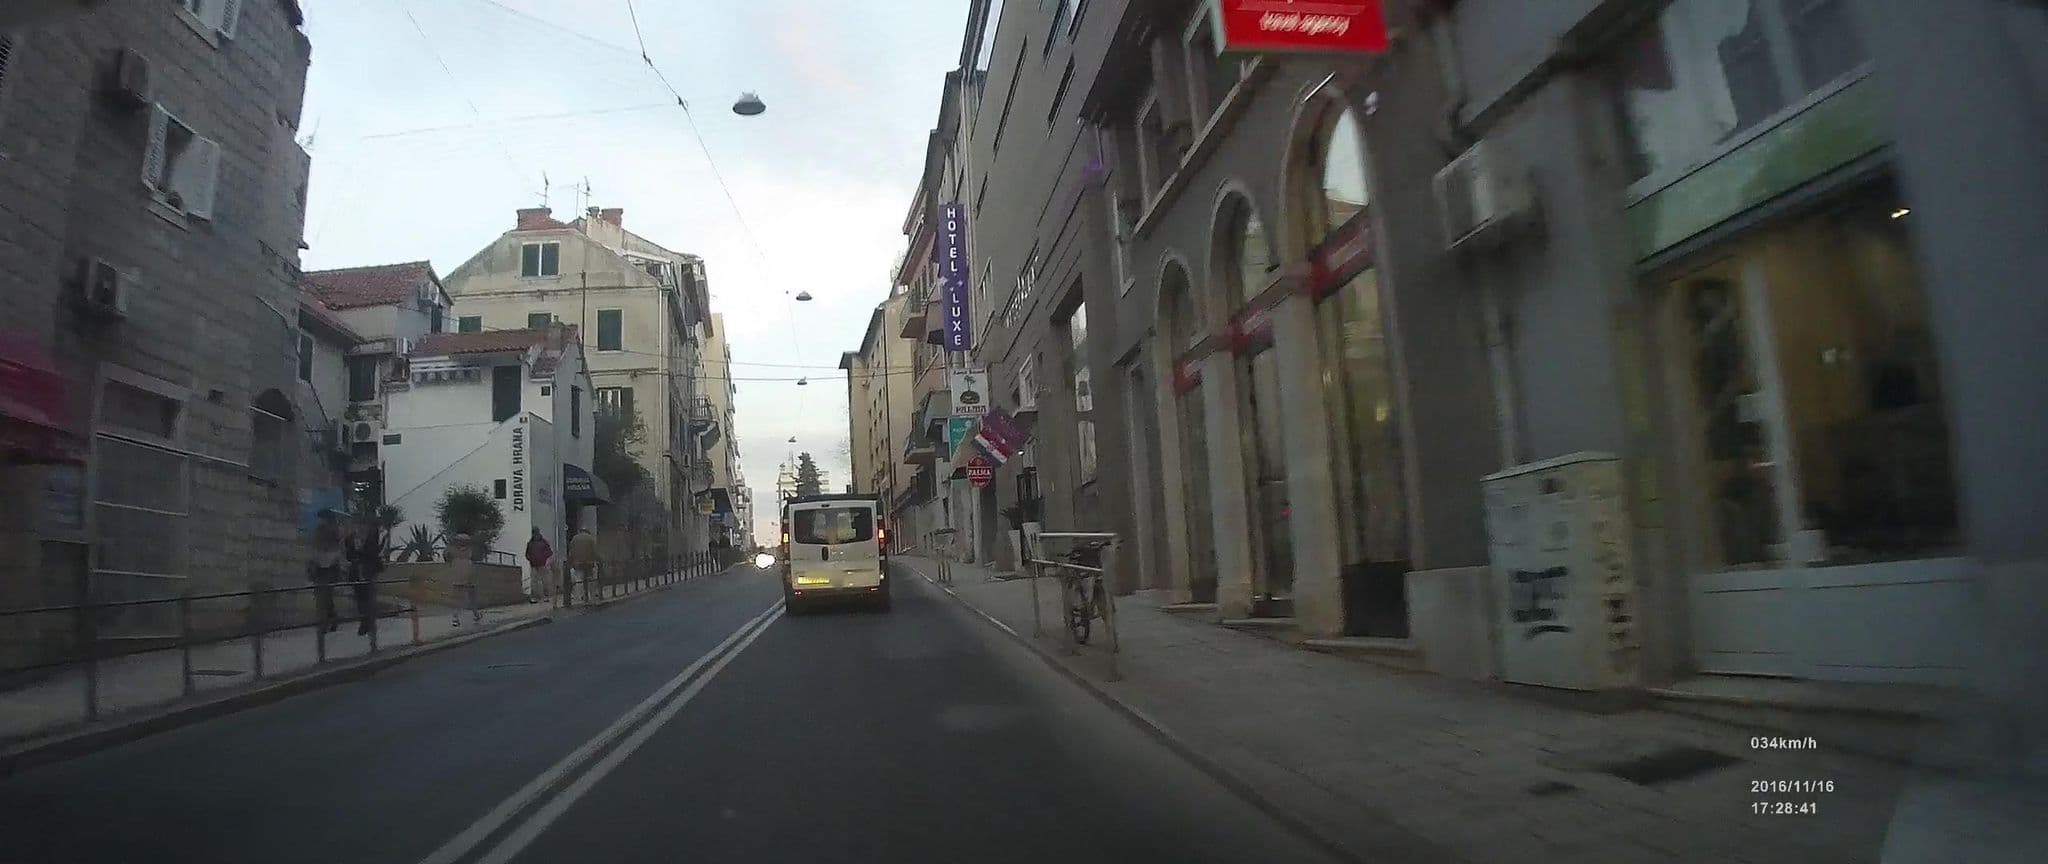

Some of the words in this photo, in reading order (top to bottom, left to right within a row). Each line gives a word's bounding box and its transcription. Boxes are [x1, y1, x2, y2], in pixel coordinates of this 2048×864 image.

[946, 207, 958, 273] HOTEL
[952, 292, 962, 346] LUXE
[512, 427, 523, 465] HRANA
[513, 469, 524, 512] ZDRAVA
